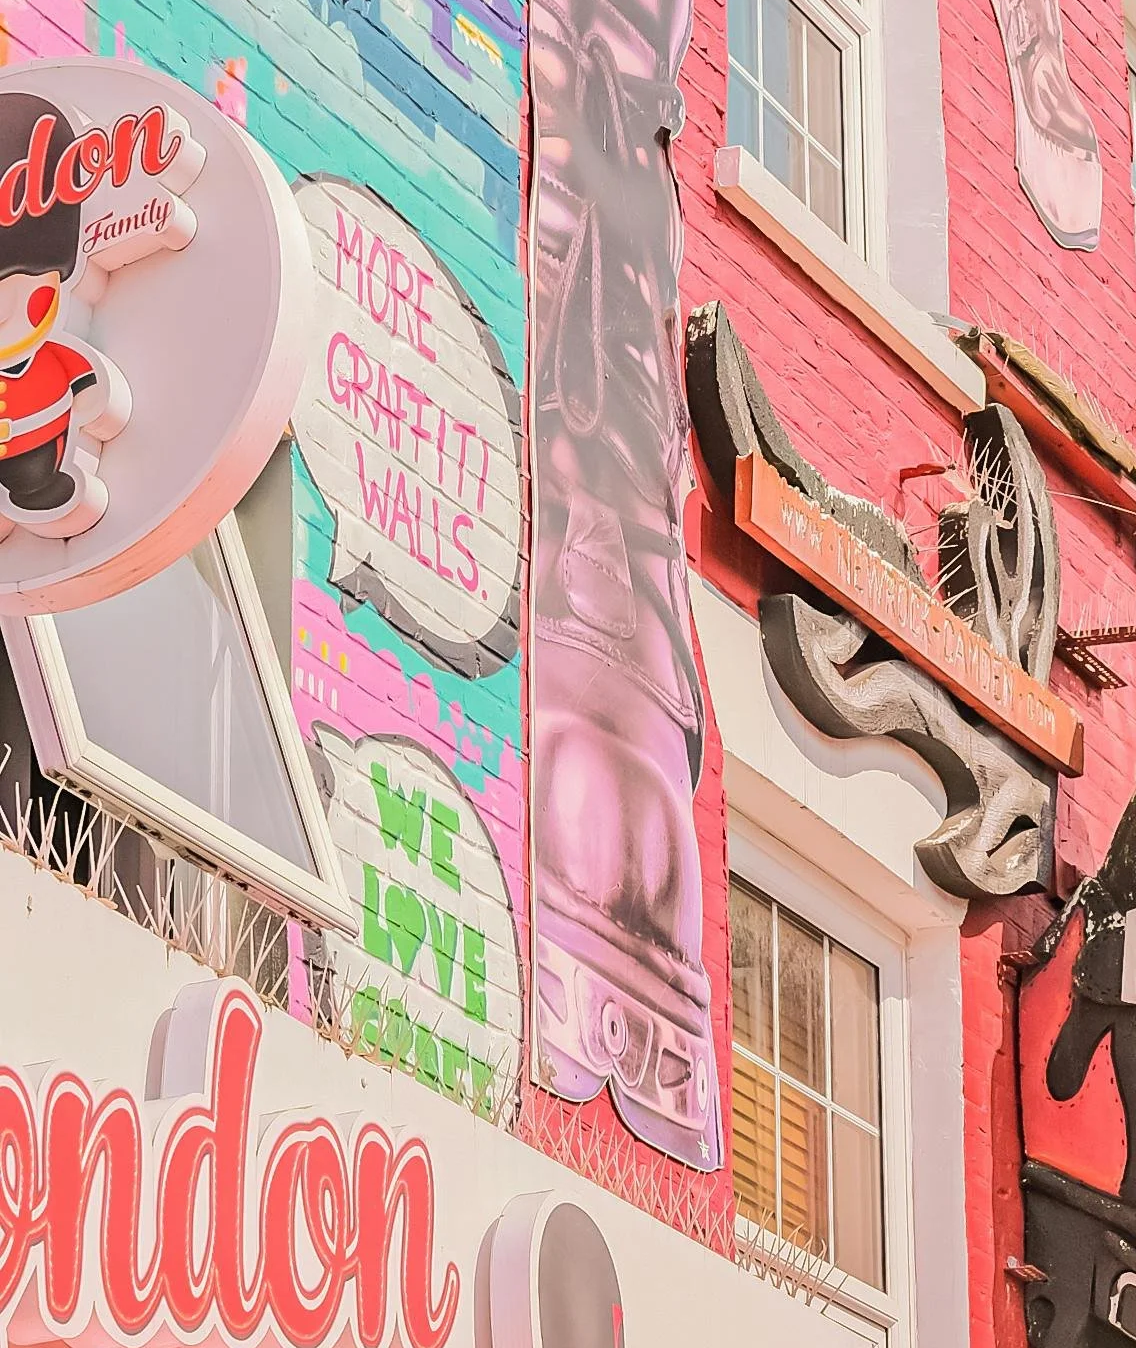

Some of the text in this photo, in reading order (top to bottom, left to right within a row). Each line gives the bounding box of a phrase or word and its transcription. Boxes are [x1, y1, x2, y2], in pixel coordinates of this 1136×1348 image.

[83, 198, 171, 253] Family
[336, 209, 437, 363] MORE
[371, 761, 462, 894] WE
[364, 864, 487, 1027] LOVE
